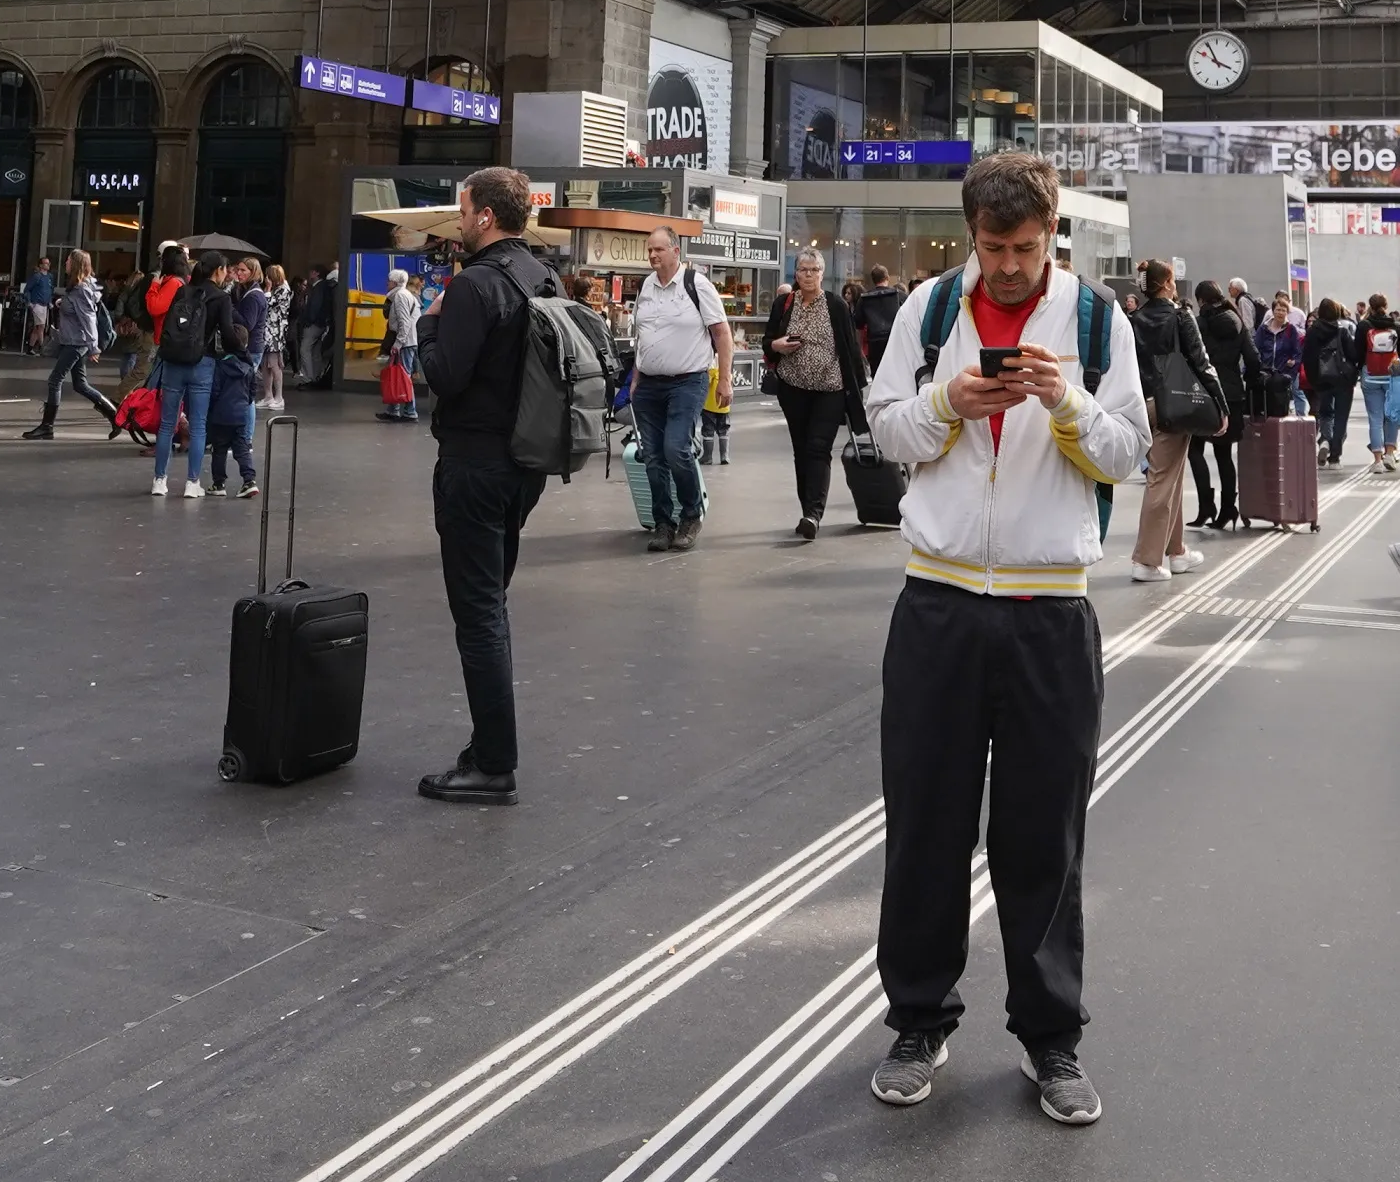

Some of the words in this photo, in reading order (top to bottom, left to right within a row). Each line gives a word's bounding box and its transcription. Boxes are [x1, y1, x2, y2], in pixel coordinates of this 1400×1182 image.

[453, 99, 462, 112] 21
[474, 103, 484, 116] 34
[647, 106, 703, 140] TRADE
[866, 150, 878, 161] 21
[898, 150, 912, 161] 34
[1271, 142, 1313, 172] Es
[1321, 141, 1397, 172] lebe
[716, 200, 734, 214] BUFFET
[736, 202, 756, 218] EXPRESS
